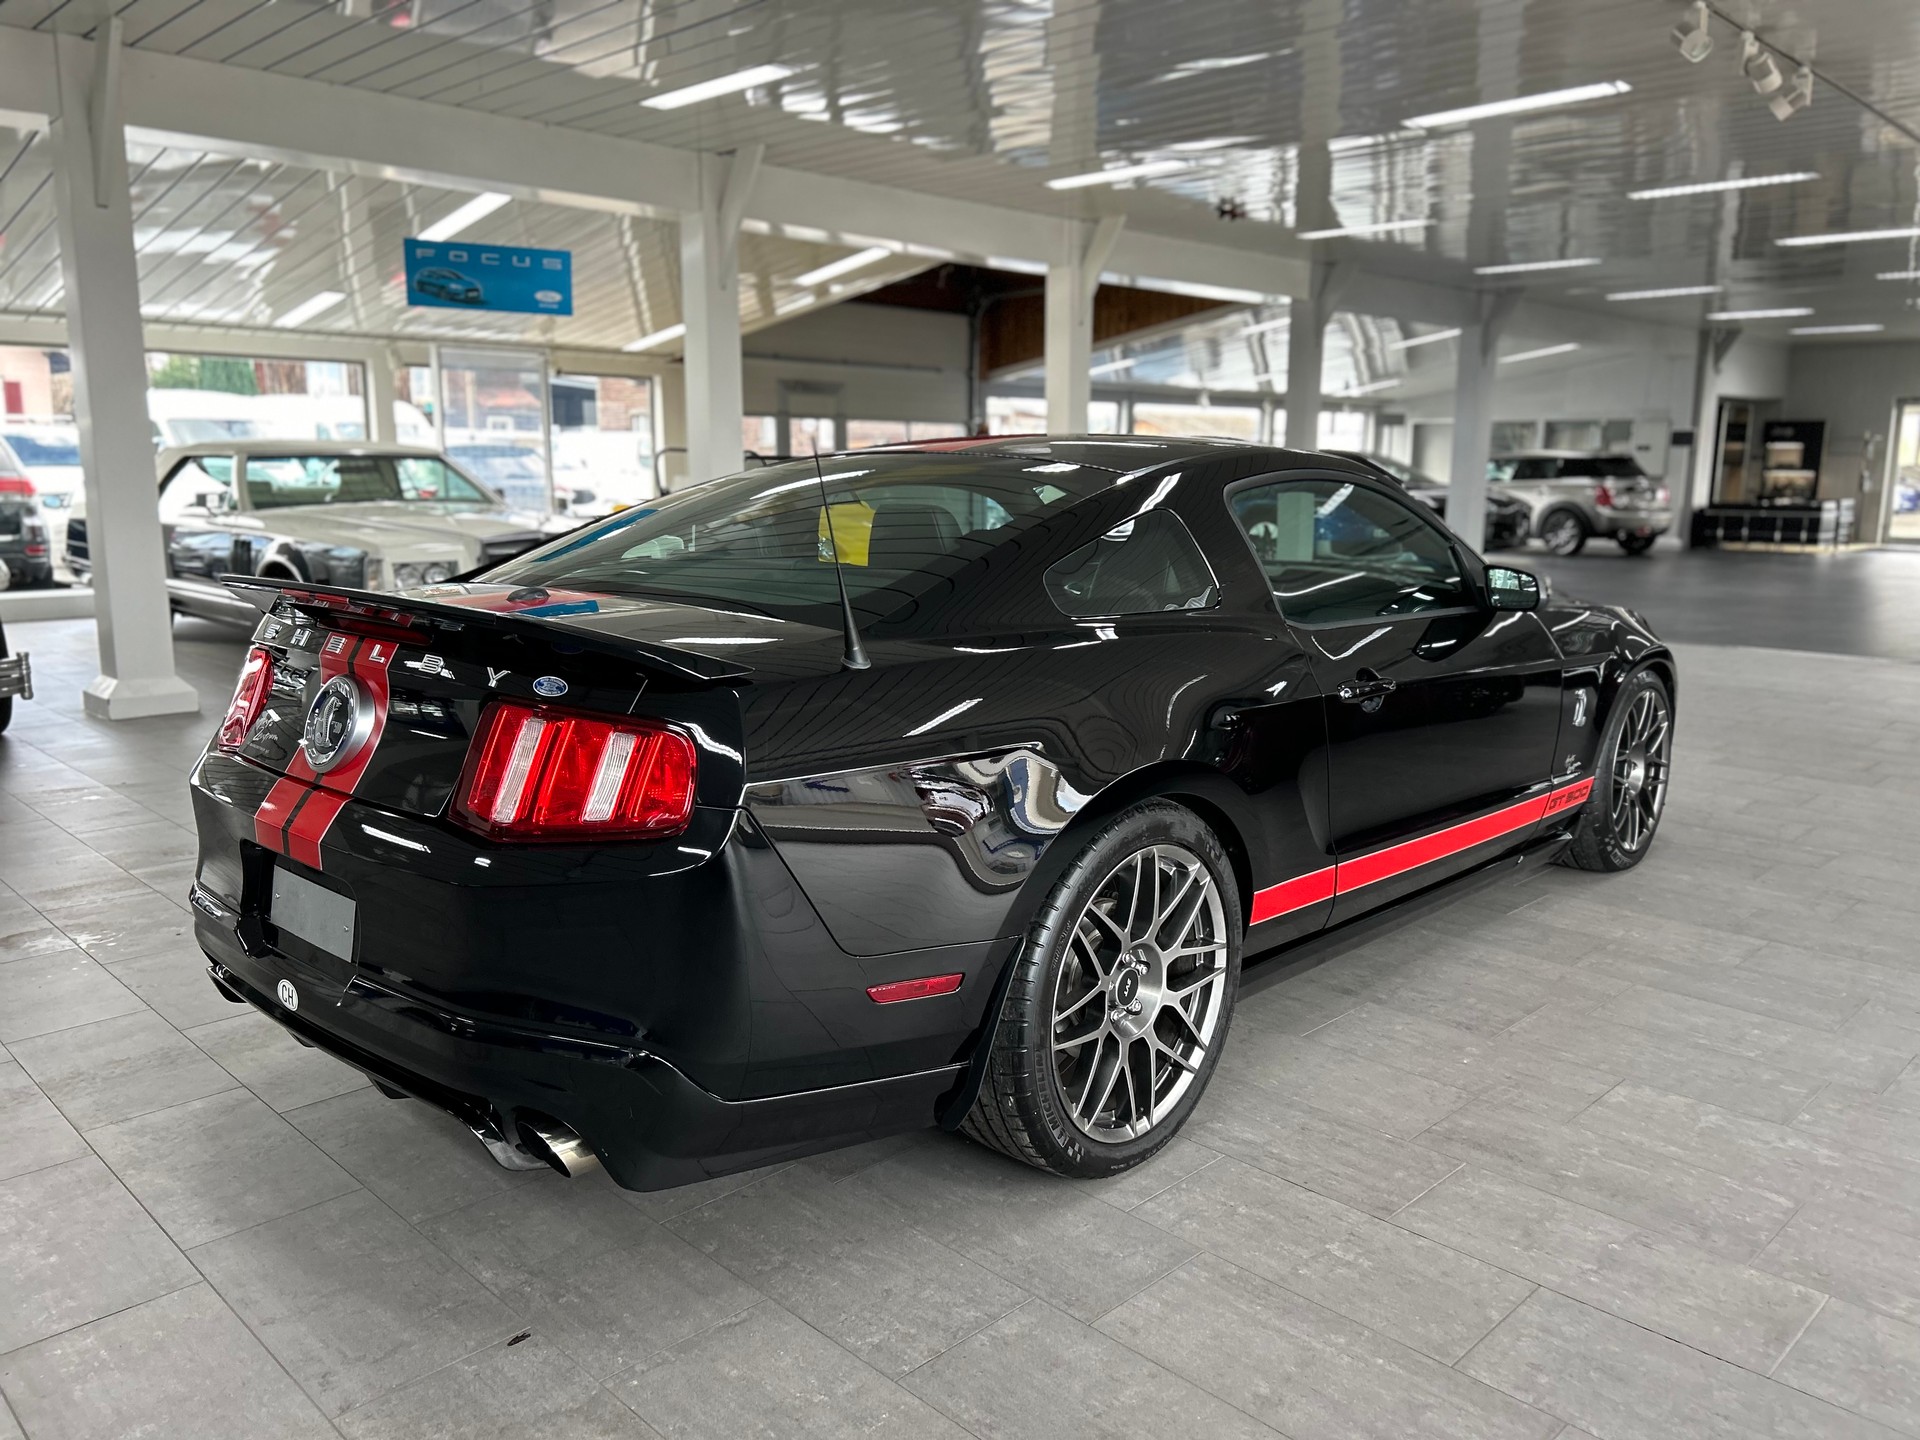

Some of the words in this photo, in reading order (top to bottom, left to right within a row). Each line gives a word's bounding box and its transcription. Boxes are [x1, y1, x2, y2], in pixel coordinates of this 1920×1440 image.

[415, 248, 563, 271] FOCUS
[263, 623, 511, 688] SHELBY
[281, 983, 295, 1008] CH
